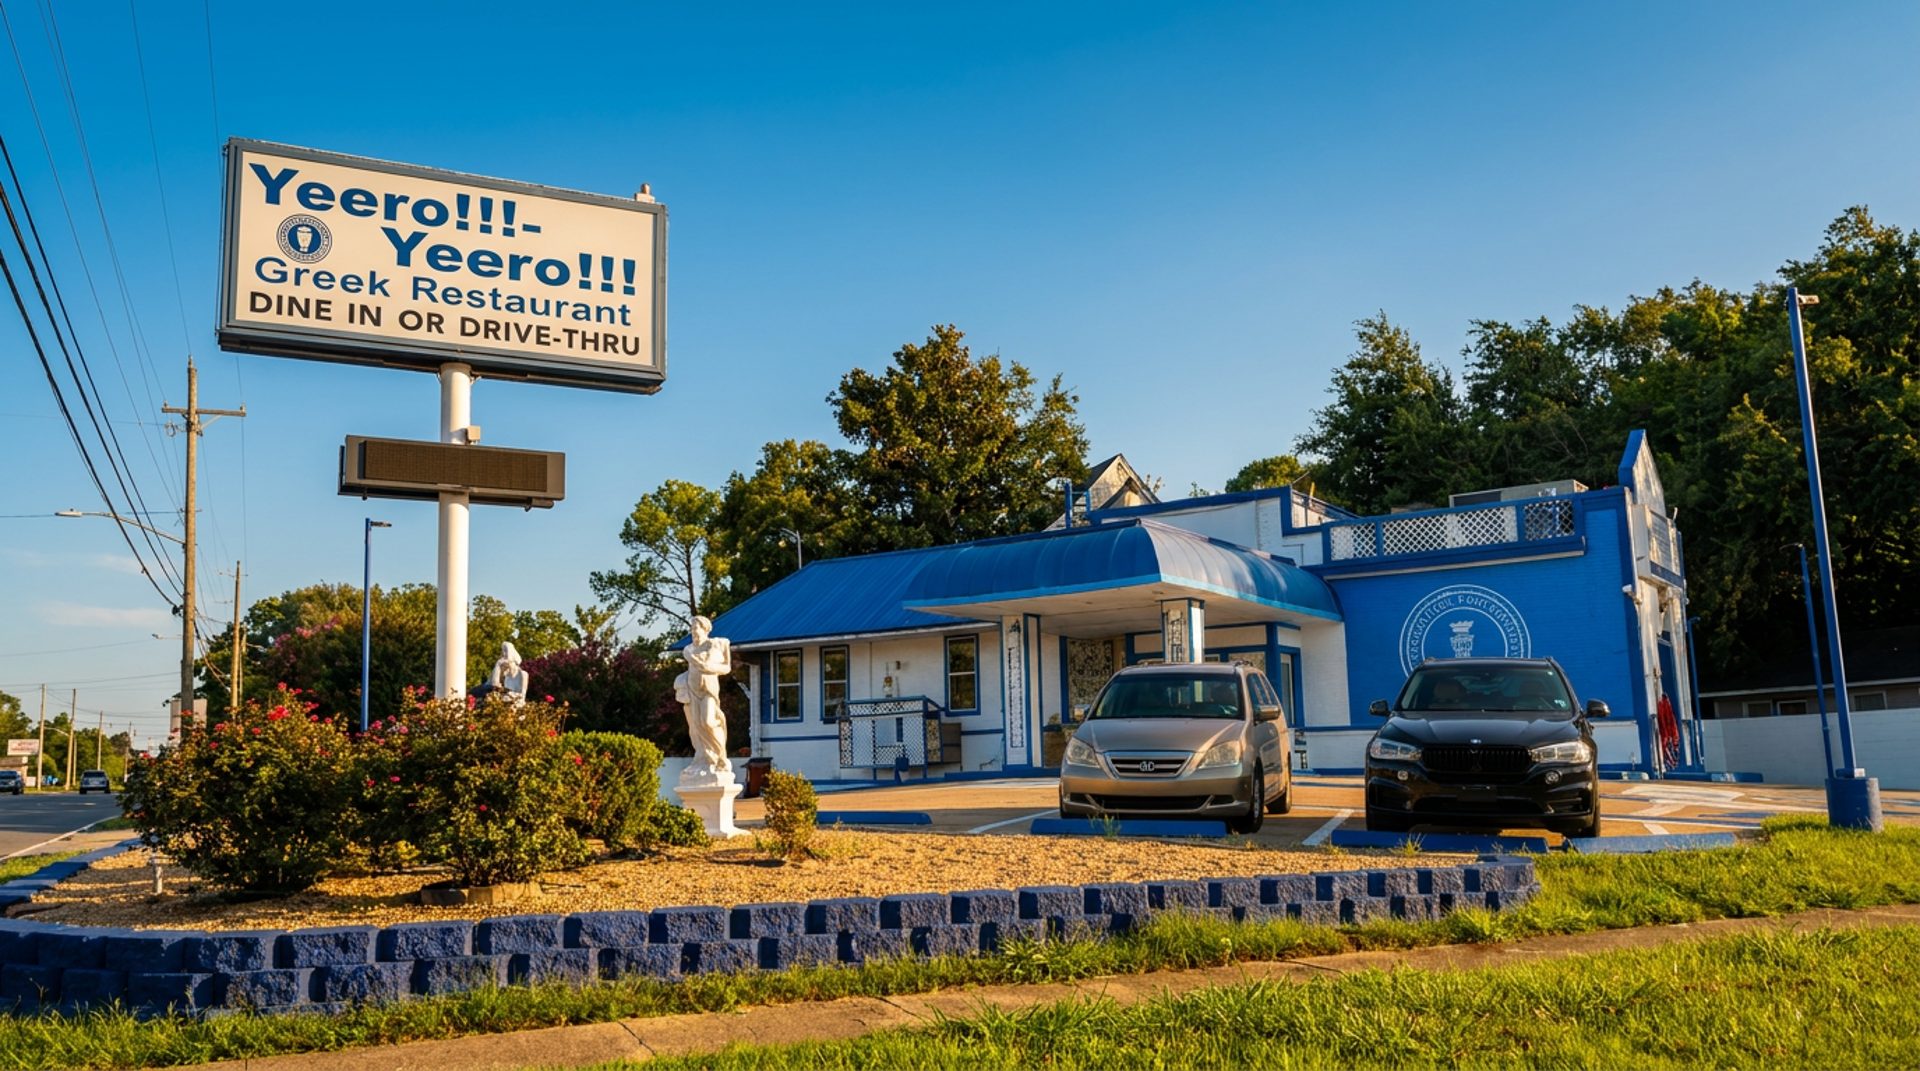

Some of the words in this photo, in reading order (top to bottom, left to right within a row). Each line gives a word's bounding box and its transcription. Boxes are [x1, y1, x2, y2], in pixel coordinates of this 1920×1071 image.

[254, 256, 390, 298] Greek
[412, 276, 631, 326] Restaurant
[381, 227, 637, 296] Yeero!!!
[249, 291, 332, 322] DINE
[348, 302, 382, 327] IN
[398, 309, 445, 334] OR
[459, 316, 640, 356] DRIVE-THRU
